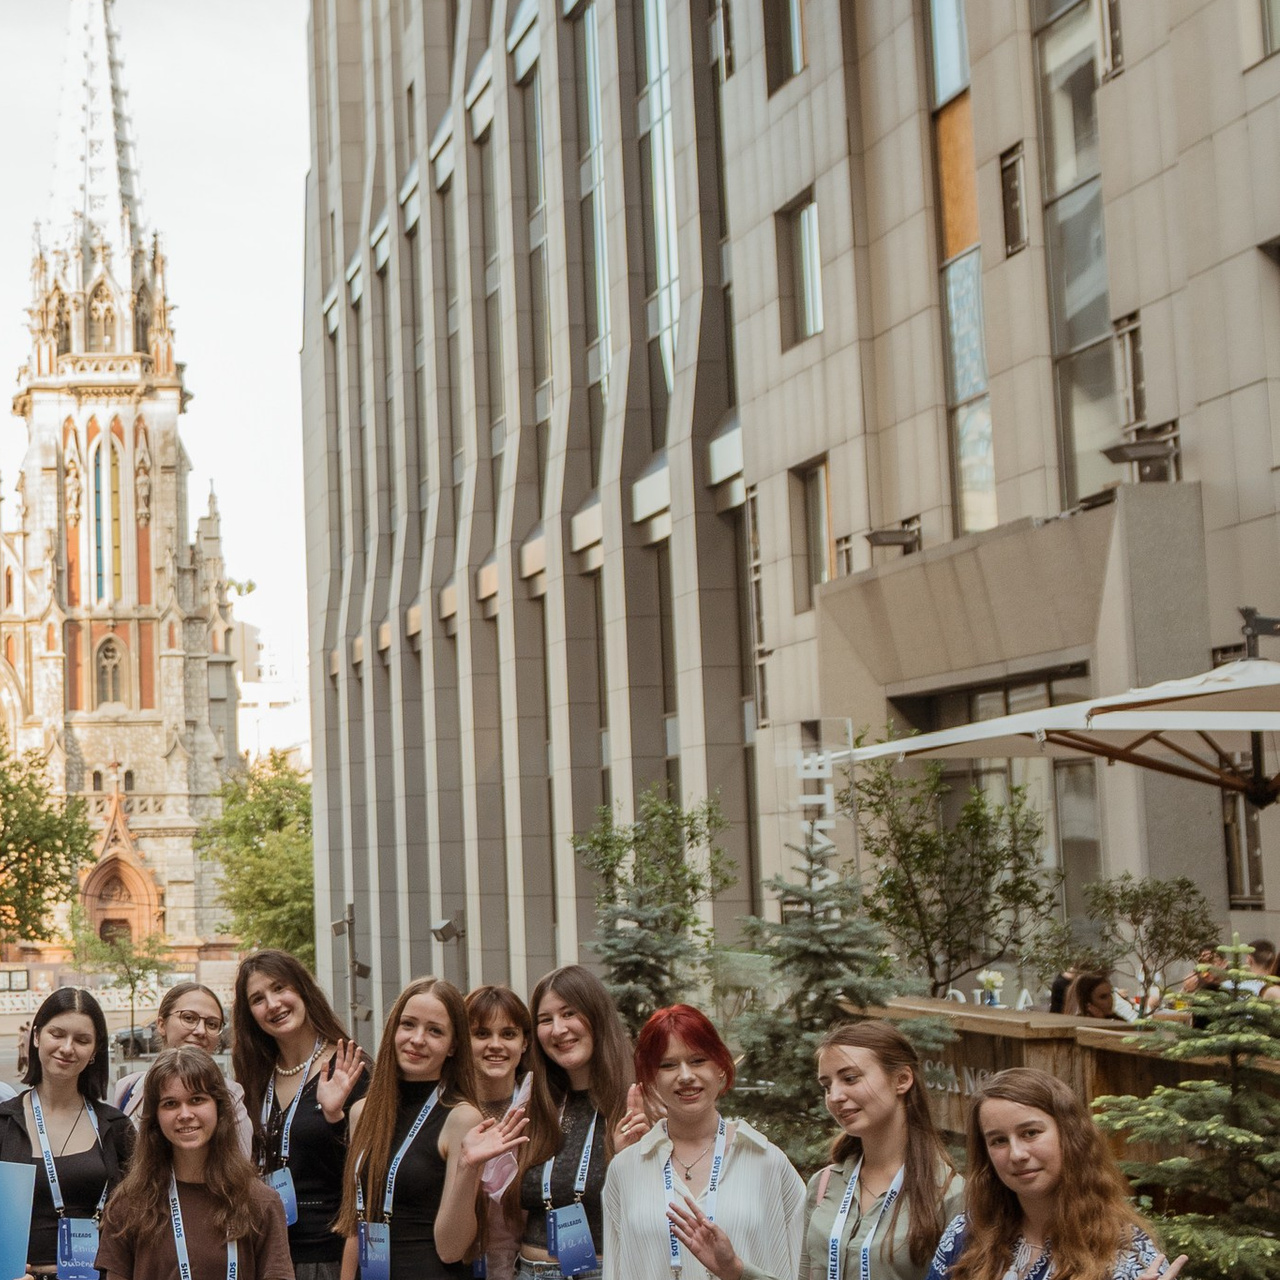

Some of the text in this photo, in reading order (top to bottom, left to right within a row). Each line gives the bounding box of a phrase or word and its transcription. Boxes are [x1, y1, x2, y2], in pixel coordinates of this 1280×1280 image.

[34, 1105, 45, 1135] SHELEADS
[409, 1104, 431, 1138] SHELEADS
[44, 1150, 56, 1184] SHELEADS
[387, 1156, 401, 1195] SHELEADS
[579, 1145, 590, 1182] SHELEADS
[710, 1156, 721, 1192] SHELEADS
[840, 1175, 857, 1214] SHELEADS
[170, 1197, 182, 1239] SHELEADS
[558, 1218, 582, 1229] SHELEADS
